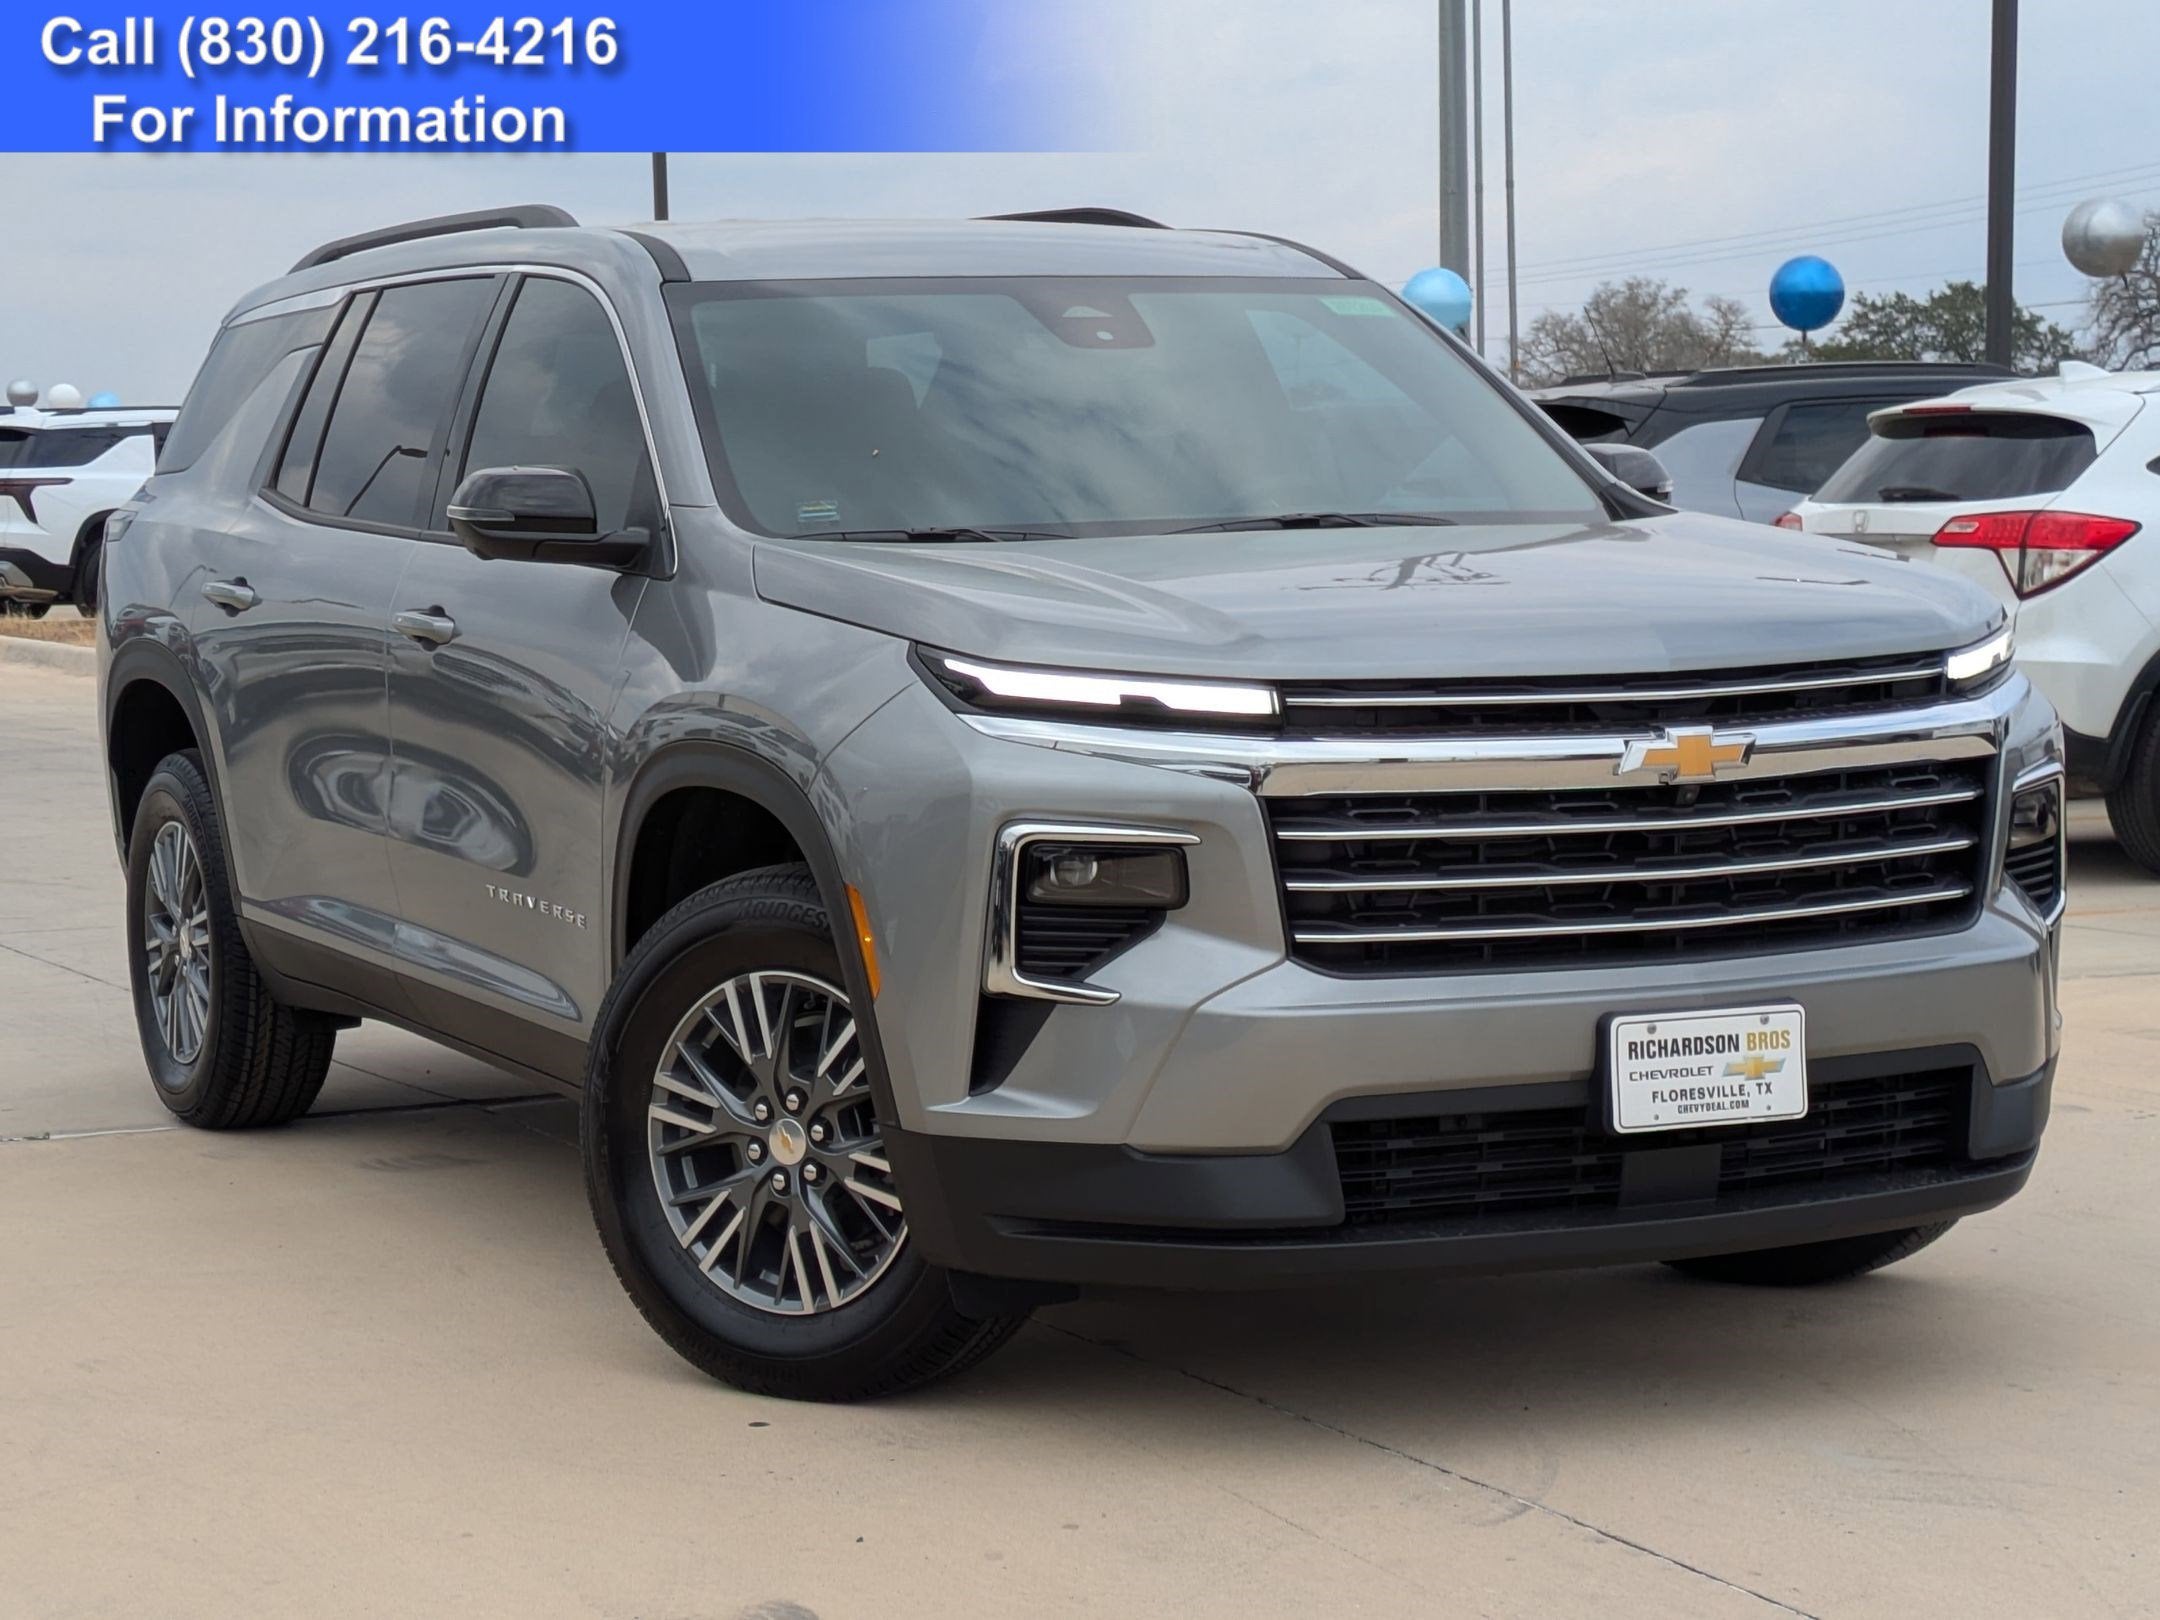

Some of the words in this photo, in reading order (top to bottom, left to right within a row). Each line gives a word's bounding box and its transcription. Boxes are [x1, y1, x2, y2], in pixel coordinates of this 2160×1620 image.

[486, 884, 587, 929] TRAVERSE
[1628, 1034, 1740, 1060] RICHARDSON
[1746, 1030, 1791, 1051] BROS
[1629, 1066, 1714, 1082] CHEVROLET
[1652, 1083, 1751, 1103] FLORESVILLE,
[1756, 1082, 1773, 1095] TX
[1677, 1100, 1750, 1114] CHEVYDEAL.COM
